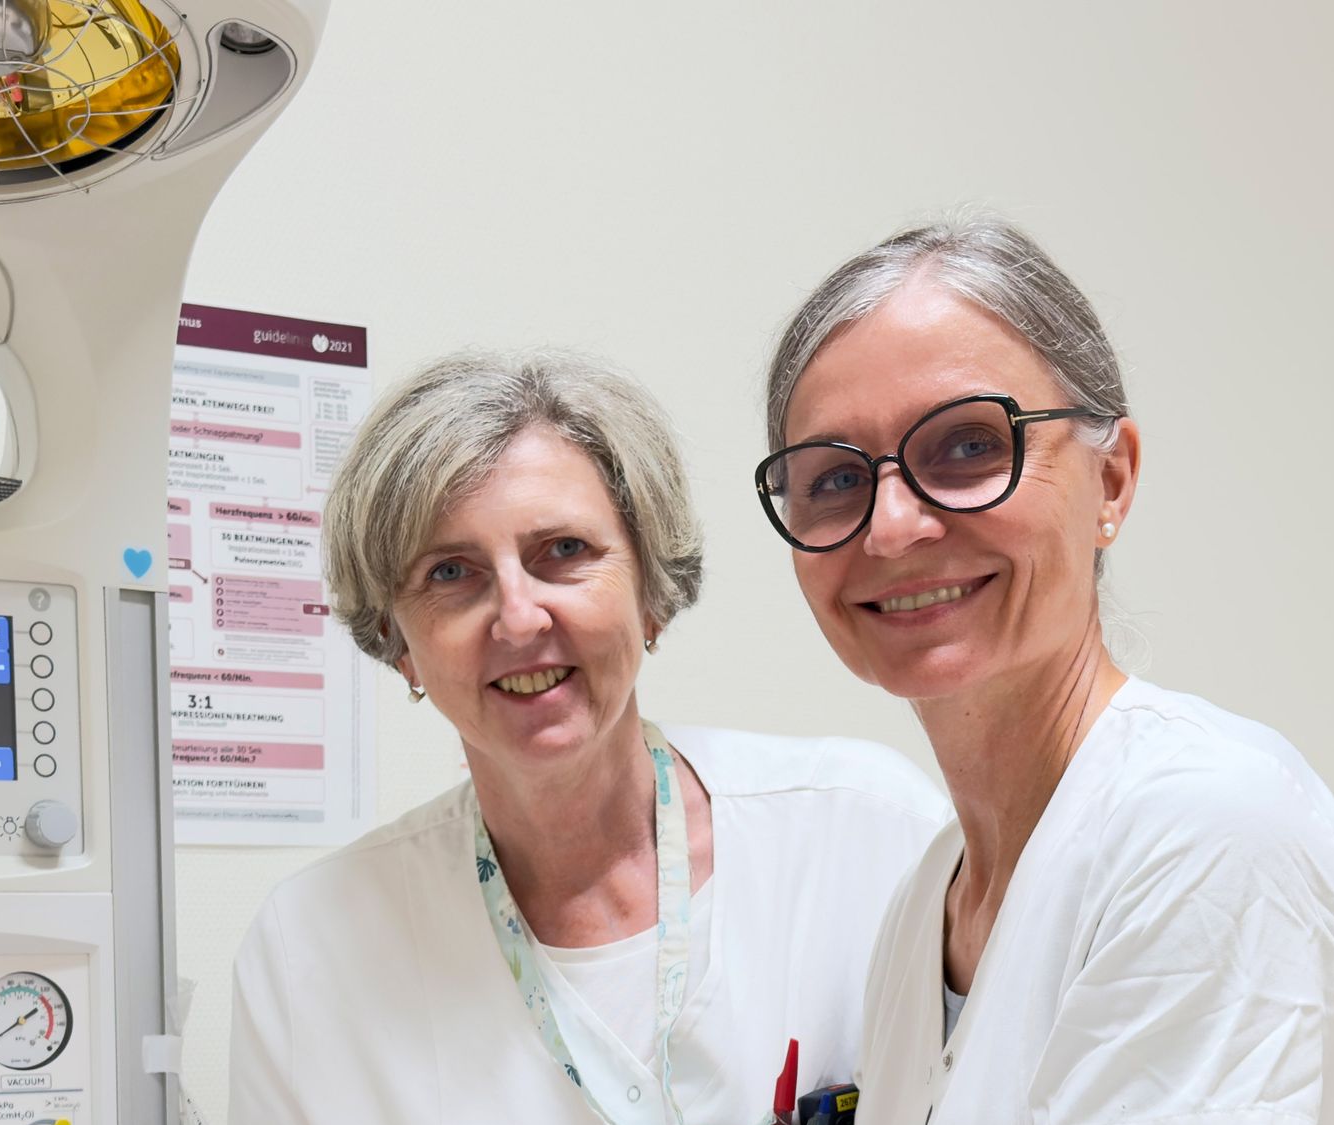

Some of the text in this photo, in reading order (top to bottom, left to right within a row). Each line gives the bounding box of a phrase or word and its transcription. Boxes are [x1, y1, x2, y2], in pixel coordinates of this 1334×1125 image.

[329, 340, 352, 353] 2021
[215, 507, 273, 520] Herzfrequenz
[187, 694, 214, 710] 3:1
[7, 1078, 46, 1086] VACUUM
